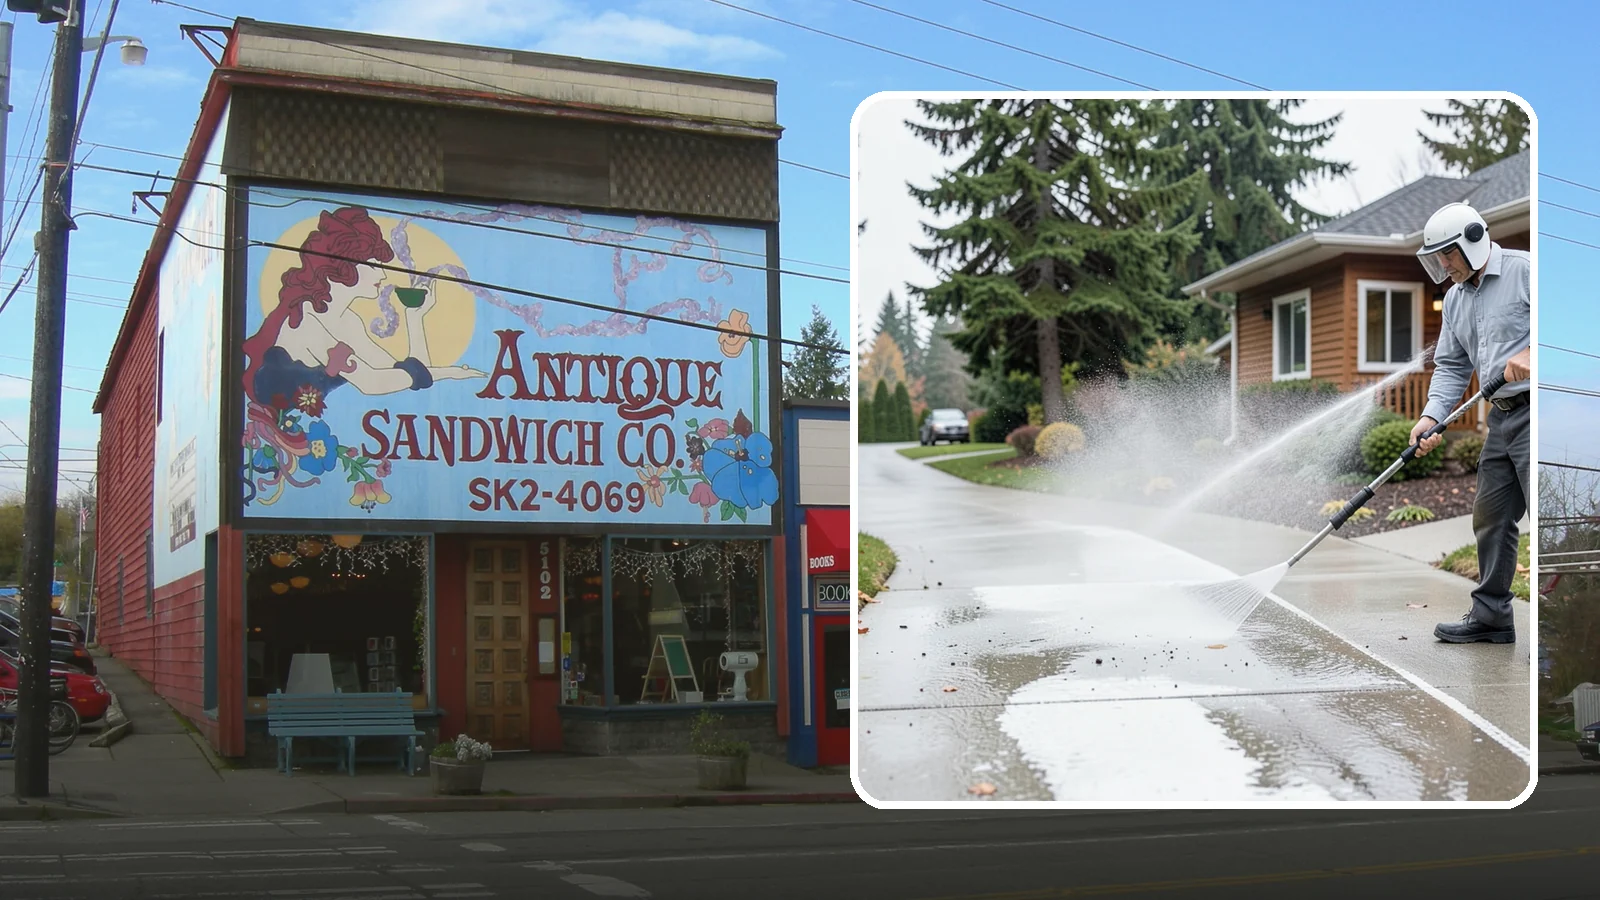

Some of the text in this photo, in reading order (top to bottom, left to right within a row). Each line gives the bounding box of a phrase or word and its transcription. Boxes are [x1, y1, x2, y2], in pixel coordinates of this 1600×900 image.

[476, 329, 723, 420] ANTIQUE
[361, 409, 684, 468] SANDWICH CO.
[468, 478, 645, 513] SK2-4069
[539, 542, 552, 599] 5102
[809, 555, 834, 568] BOOKS
